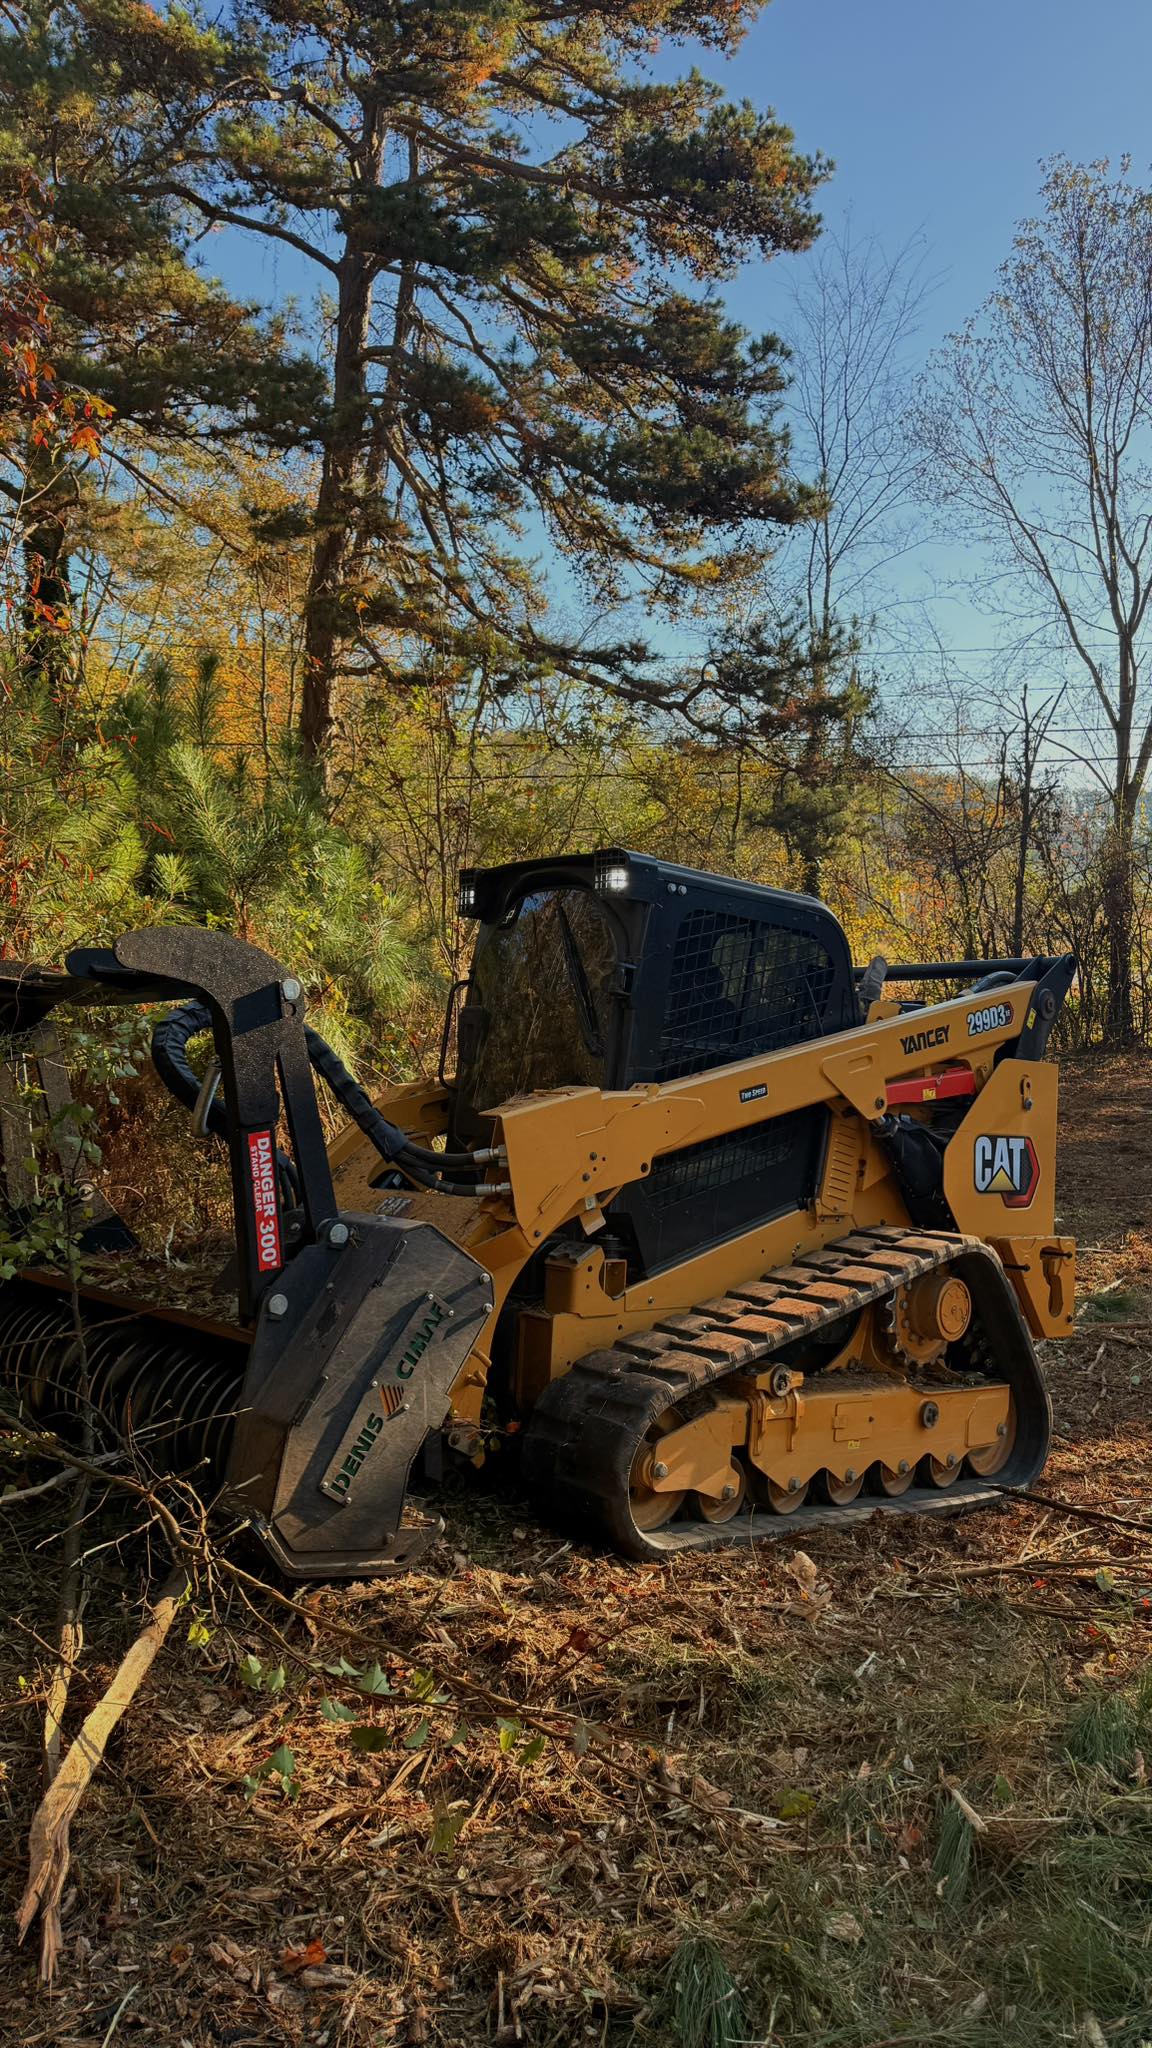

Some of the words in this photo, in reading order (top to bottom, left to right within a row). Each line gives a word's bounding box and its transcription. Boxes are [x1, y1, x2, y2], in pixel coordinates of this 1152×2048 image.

[967, 1004, 1005, 1036] 299D3
[899, 1025, 950, 1055] YANCEY
[250, 1145, 259, 1177] STAND
[257, 1137, 276, 1216] DANGER
[975, 1136, 1025, 1191] CAT
[253, 1180, 262, 1212] CLEAR
[330, 1412, 384, 1496] DENIS
[396, 1302, 445, 1380] CIMAF
